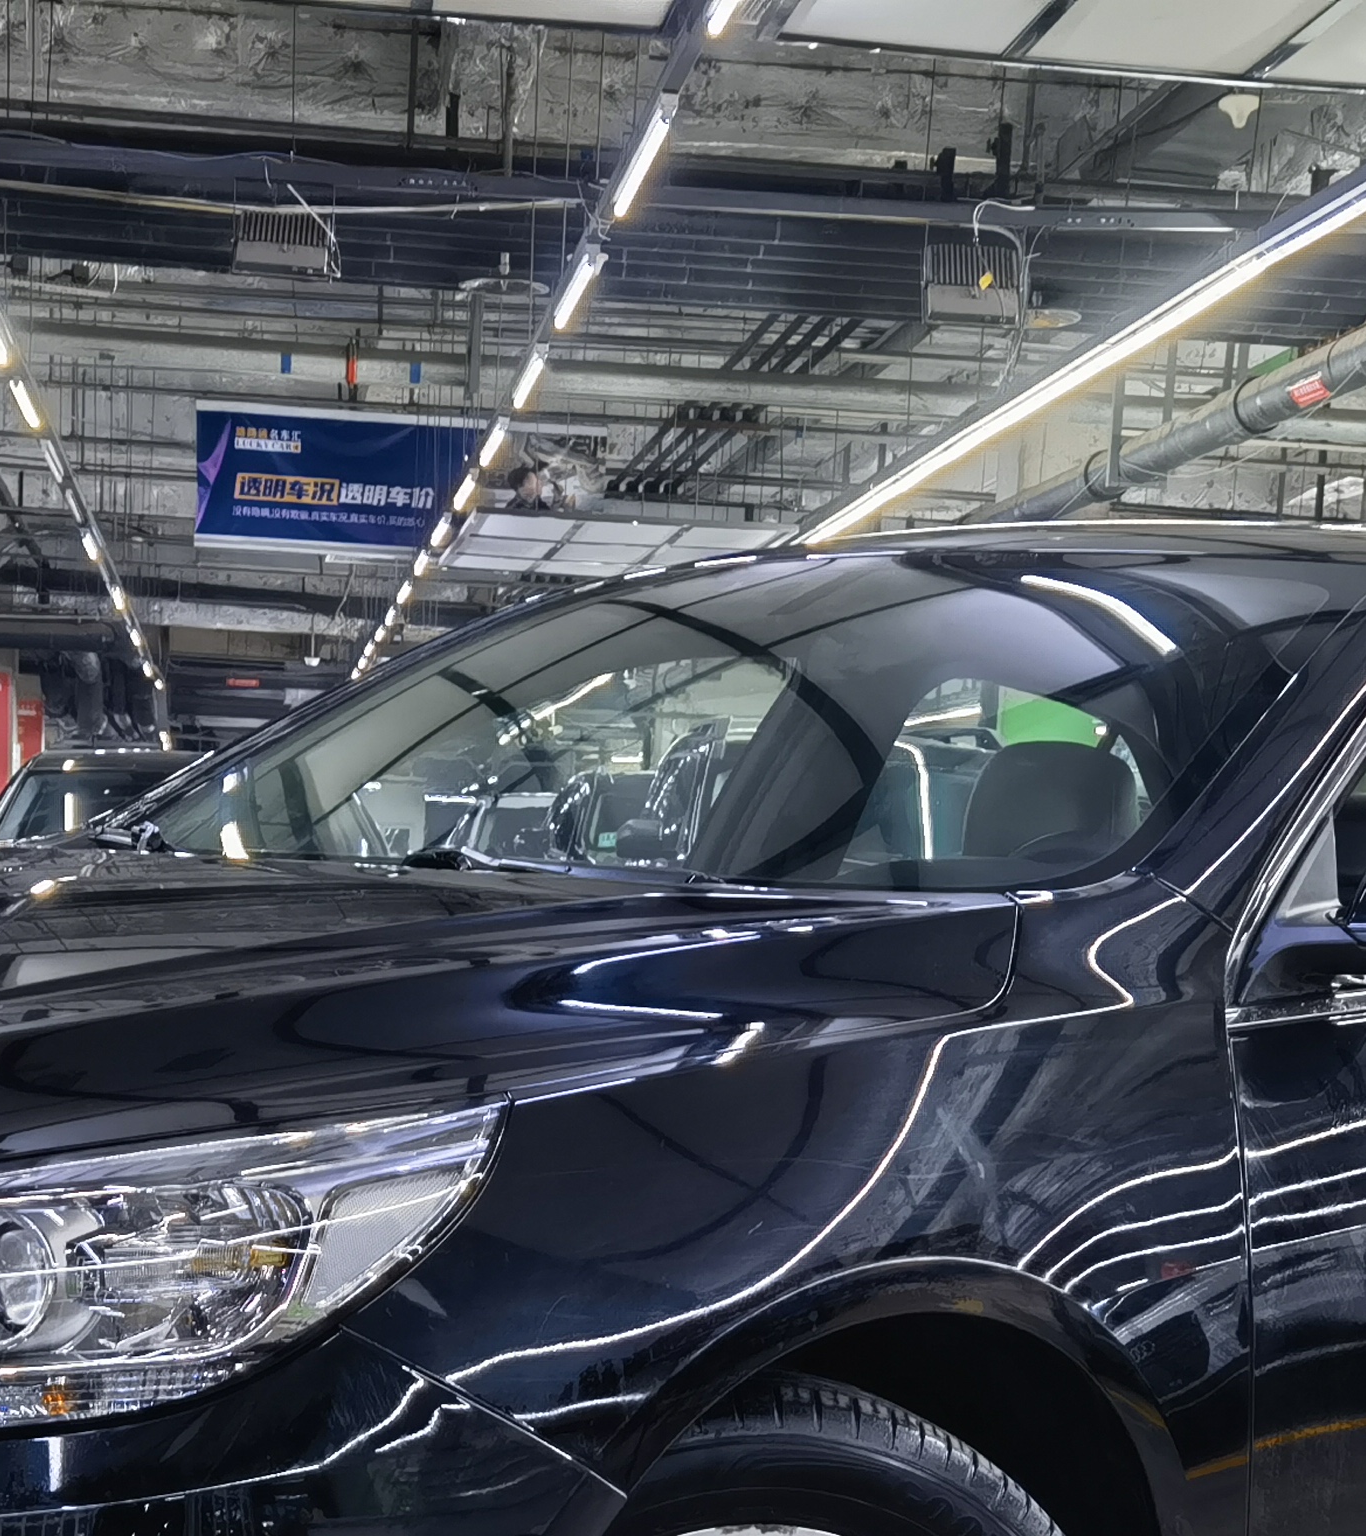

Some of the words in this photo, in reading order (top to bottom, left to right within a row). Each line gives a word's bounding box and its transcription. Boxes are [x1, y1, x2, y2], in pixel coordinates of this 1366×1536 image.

[239, 476, 335, 503] 透明车况
[339, 482, 434, 510] 透明车价
